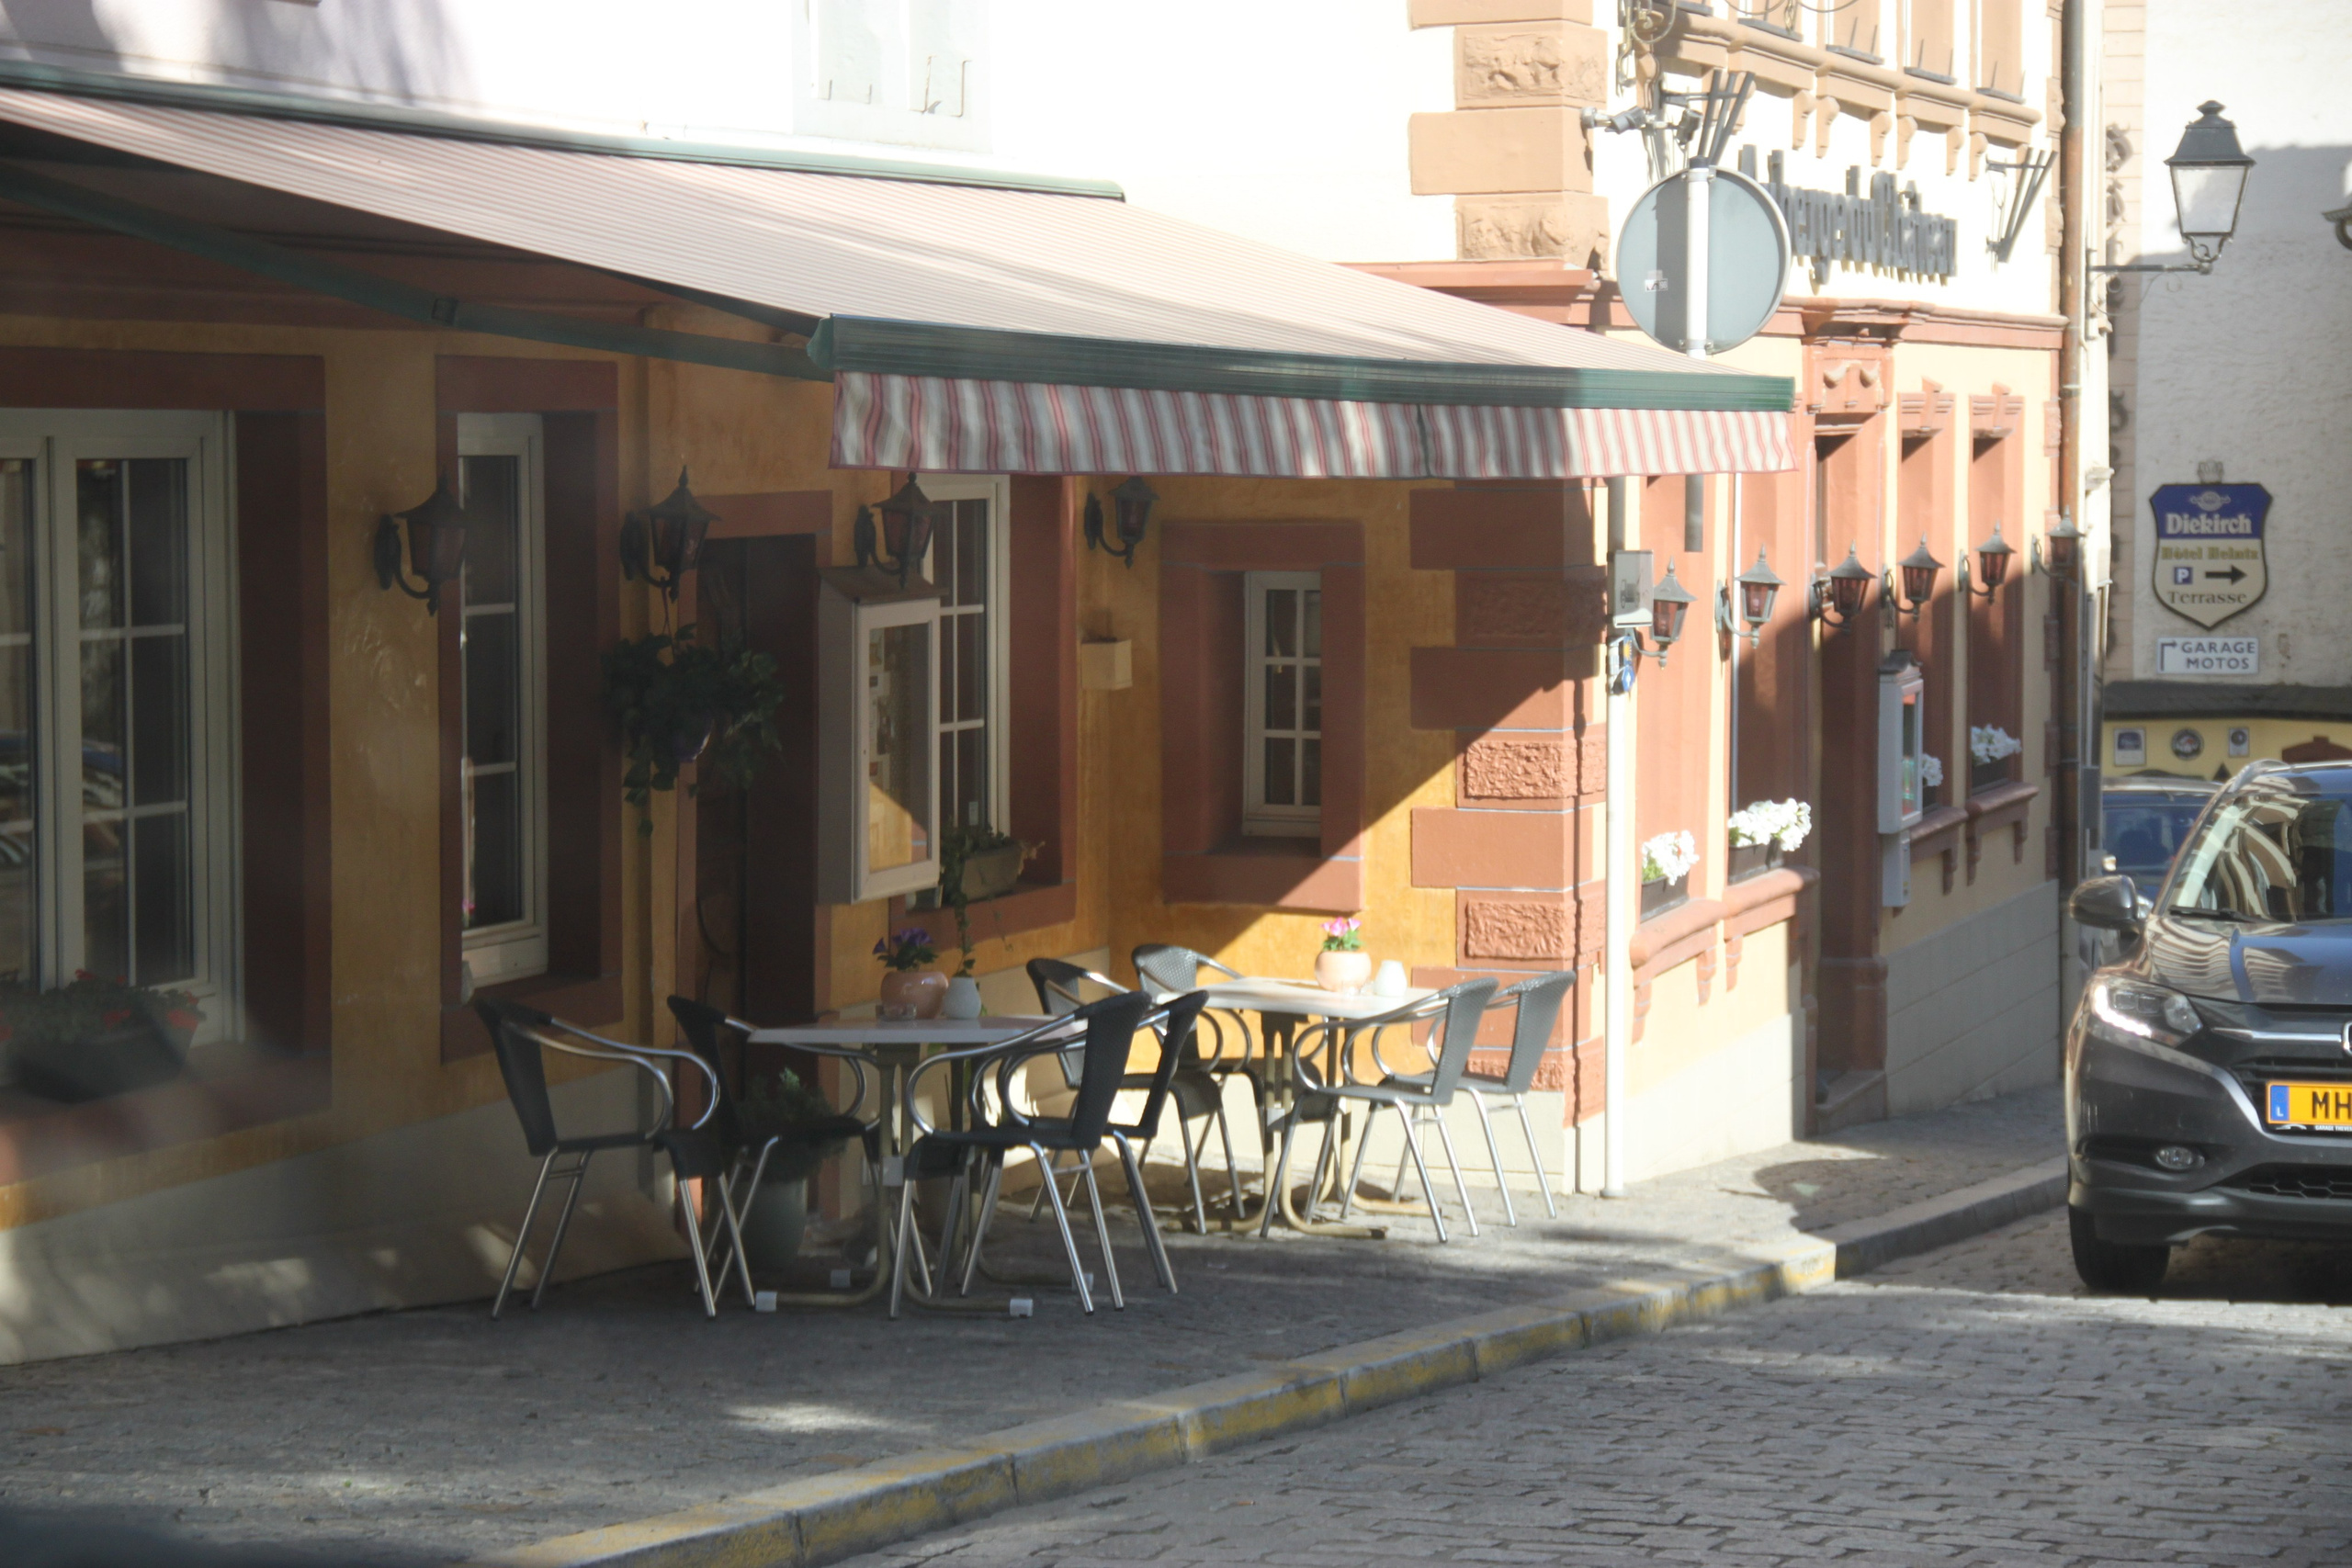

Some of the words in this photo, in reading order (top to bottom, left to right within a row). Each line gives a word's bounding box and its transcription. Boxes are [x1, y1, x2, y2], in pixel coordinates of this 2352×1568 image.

[2165, 513, 2252, 535] Diekirch
[2177, 569, 2189, 583] P
[2167, 591, 2247, 604] Terrasse
[2181, 642, 2256, 654] GARAGE
[2187, 658, 2249, 670] MOTOS
[2276, 1106, 2284, 1117] L
